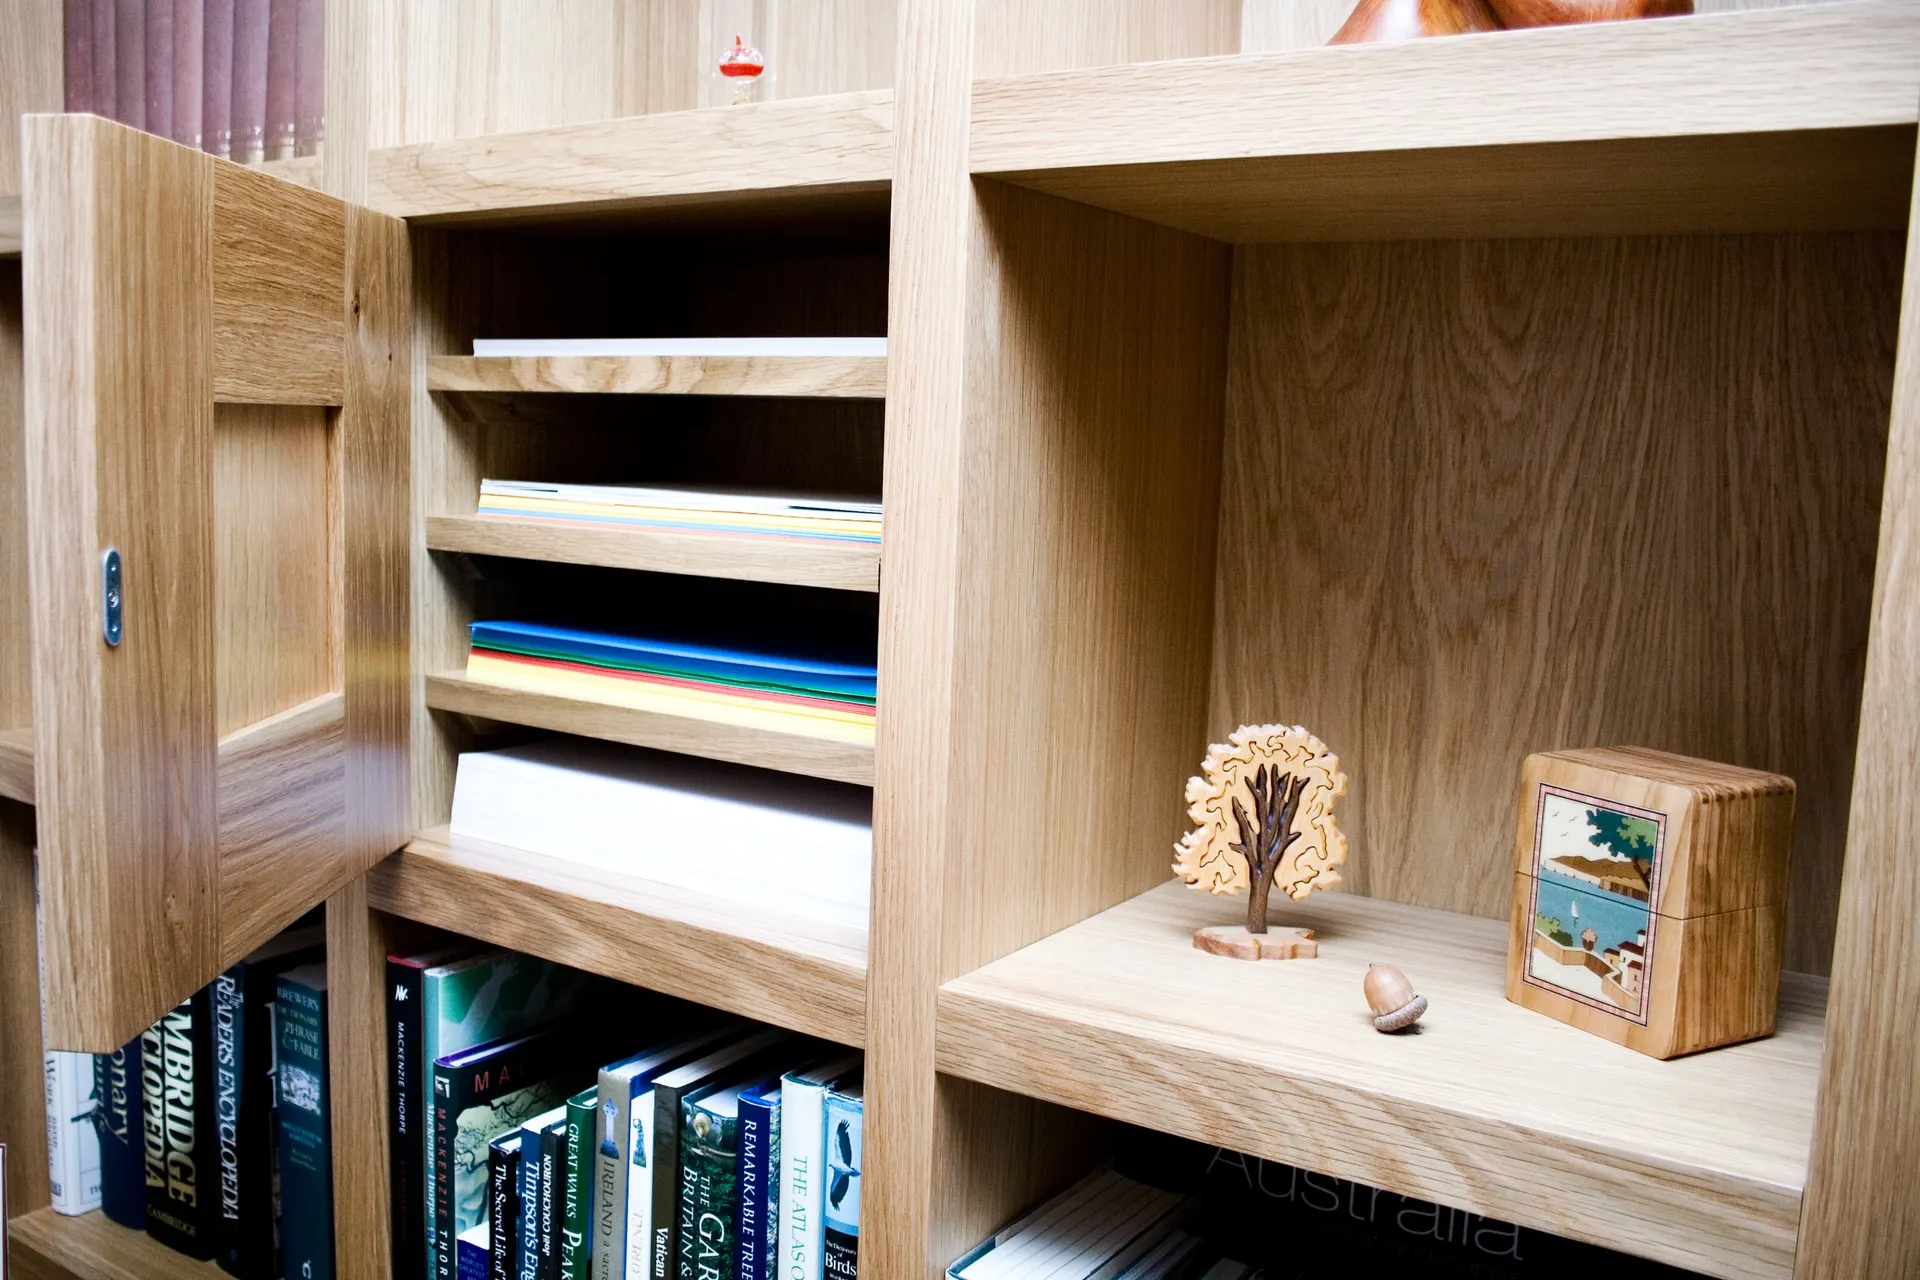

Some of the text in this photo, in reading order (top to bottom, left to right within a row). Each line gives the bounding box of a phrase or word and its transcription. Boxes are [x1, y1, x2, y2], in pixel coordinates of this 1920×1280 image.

[141, 1019, 166, 1188] CLOPEDIA
[163, 997, 197, 1208] MBRIDGE
[397, 1021, 407, 1135] MACKENZIE THORPE
[219, 1067, 239, 1220] ENCYCLOPEDIA
[495, 1164, 507, 1189] The
[566, 1122, 579, 1219] GREAT WALKS
[742, 1119, 757, 1236] REMARKABLE
[792, 1156, 807, 1197] THE
[147, 1204, 197, 1237] CAMBRIDGE
[437, 1108, 449, 1280] MACKENZIE THOR
[495, 1193, 507, 1232] Secret
[521, 1161, 540, 1249] Timpson's
[542, 1153, 552, 1233] COUCHOURON
[601, 1160, 615, 1237] IRELAND
[681, 1165, 698, 1277] BRITAIN &
[700, 1175, 711, 1208] THE
[495, 1235, 507, 1260] Life
[561, 1227, 582, 1280] PEAK
[656, 1227, 669, 1278] Vatican
[791, 1200, 807, 1263] ATLAS
[825, 1251, 857, 1276] Birds
[495, 1260, 507, 1276] of
